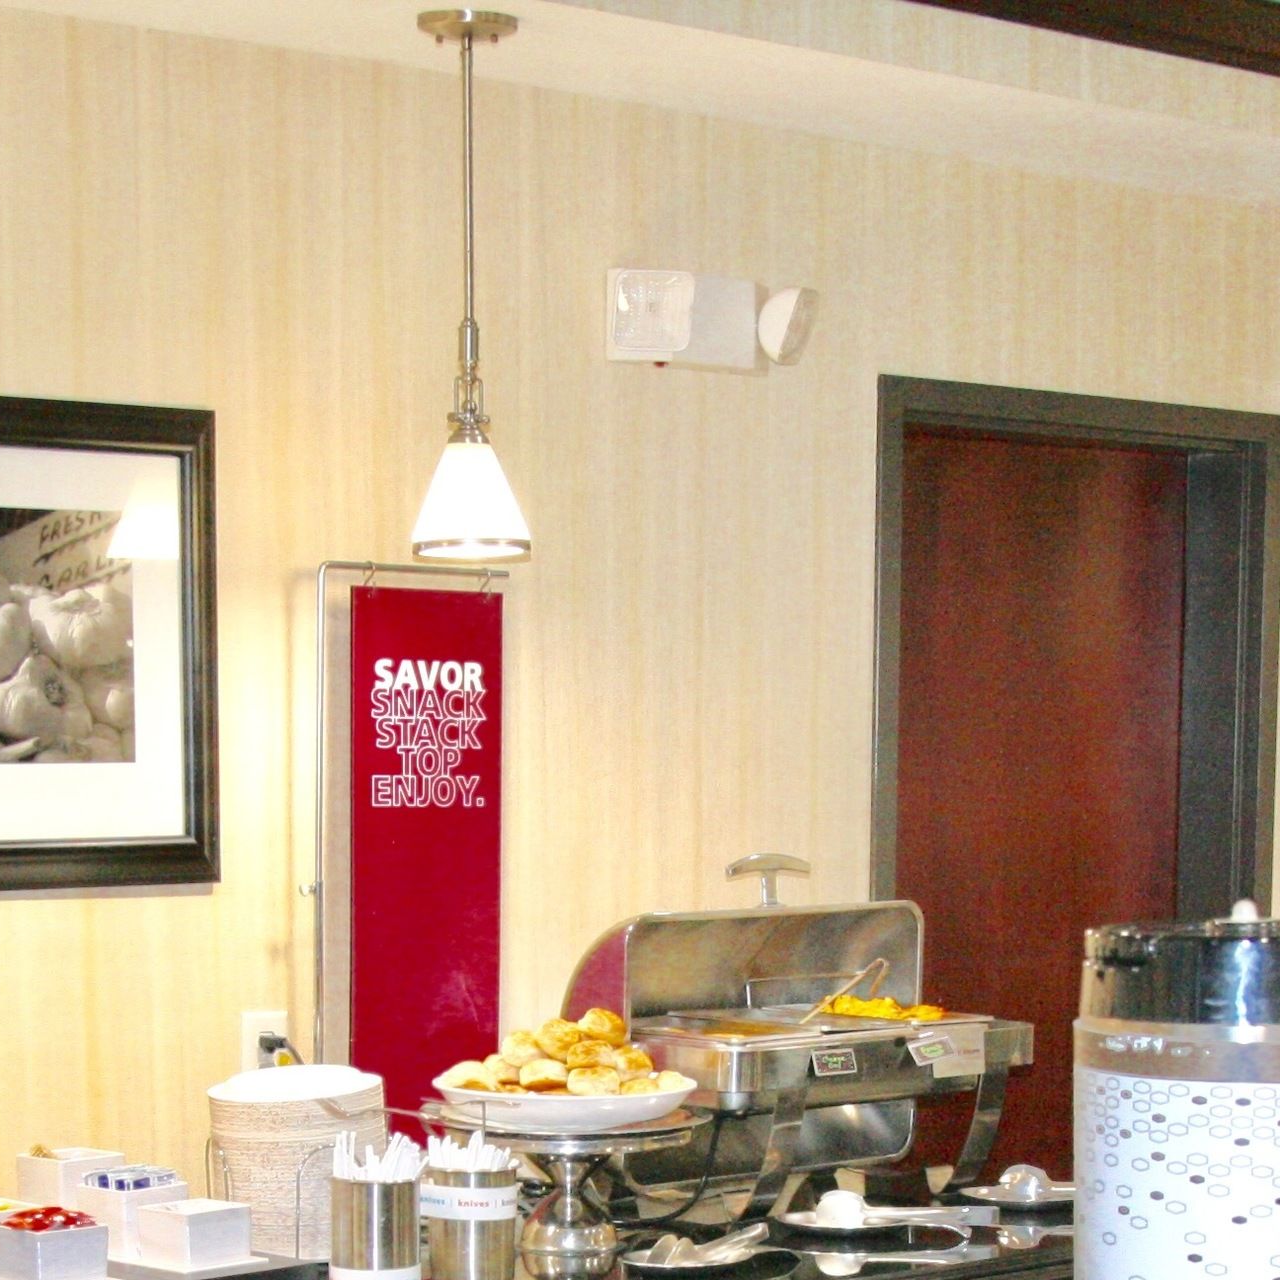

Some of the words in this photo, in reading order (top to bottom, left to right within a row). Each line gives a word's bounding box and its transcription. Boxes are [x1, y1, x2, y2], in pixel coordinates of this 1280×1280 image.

[38, 555, 114, 590] GARLI
[374, 658, 482, 691] SAVOR
[371, 687, 486, 720] SNACK
[376, 717, 481, 749] STACK
[397, 746, 461, 777] TOP
[372, 775, 485, 807] ENJOY.
[457, 1199, 490, 1207] knives
